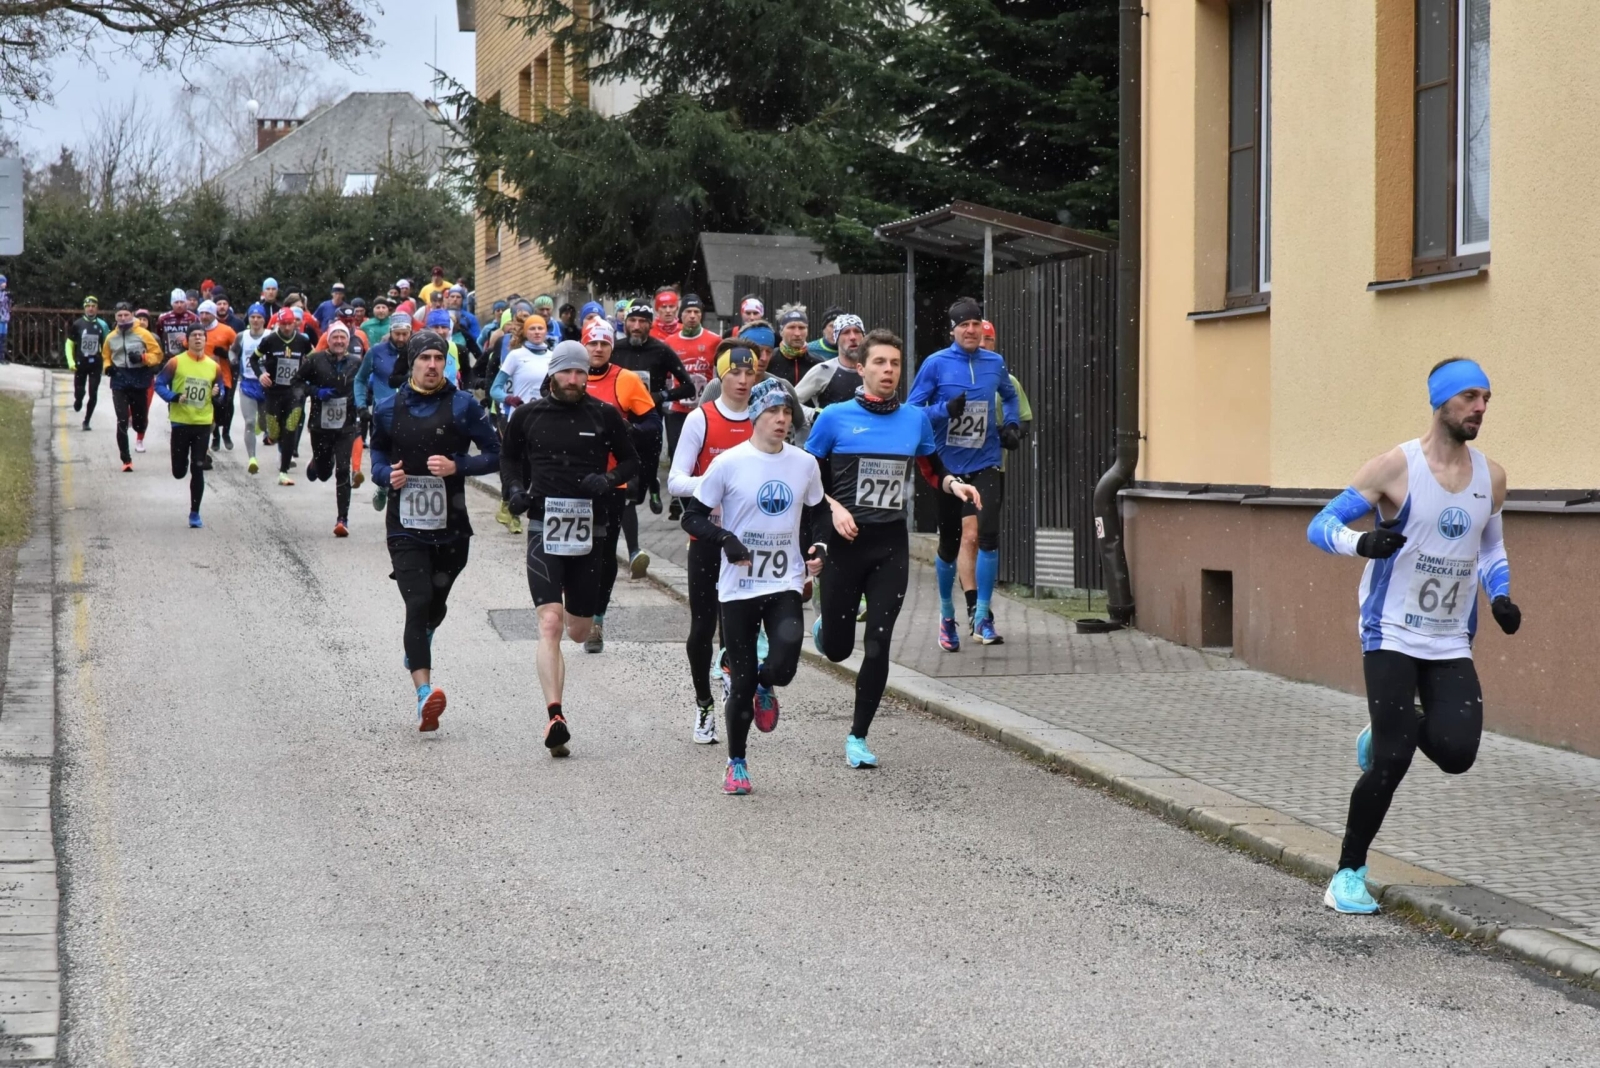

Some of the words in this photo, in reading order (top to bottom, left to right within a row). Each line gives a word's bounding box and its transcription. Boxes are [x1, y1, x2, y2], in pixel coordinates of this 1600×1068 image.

[82, 340, 97, 350] 287
[185, 386, 205, 401] 180
[327, 408, 343, 422] 99
[949, 415, 985, 437] 224
[859, 478, 901, 507] 272
[405, 491, 444, 516] 100
[546, 516, 590, 542] 275
[742, 538, 773, 546] BĚŽECKÁ
[748, 550, 788, 578] 179
[1418, 553, 1445, 565] ZIMNÍ
[1415, 562, 1453, 575] BĚŽECKÁ
[1456, 568, 1471, 576] LIGA
[1418, 578, 1460, 615] 64
